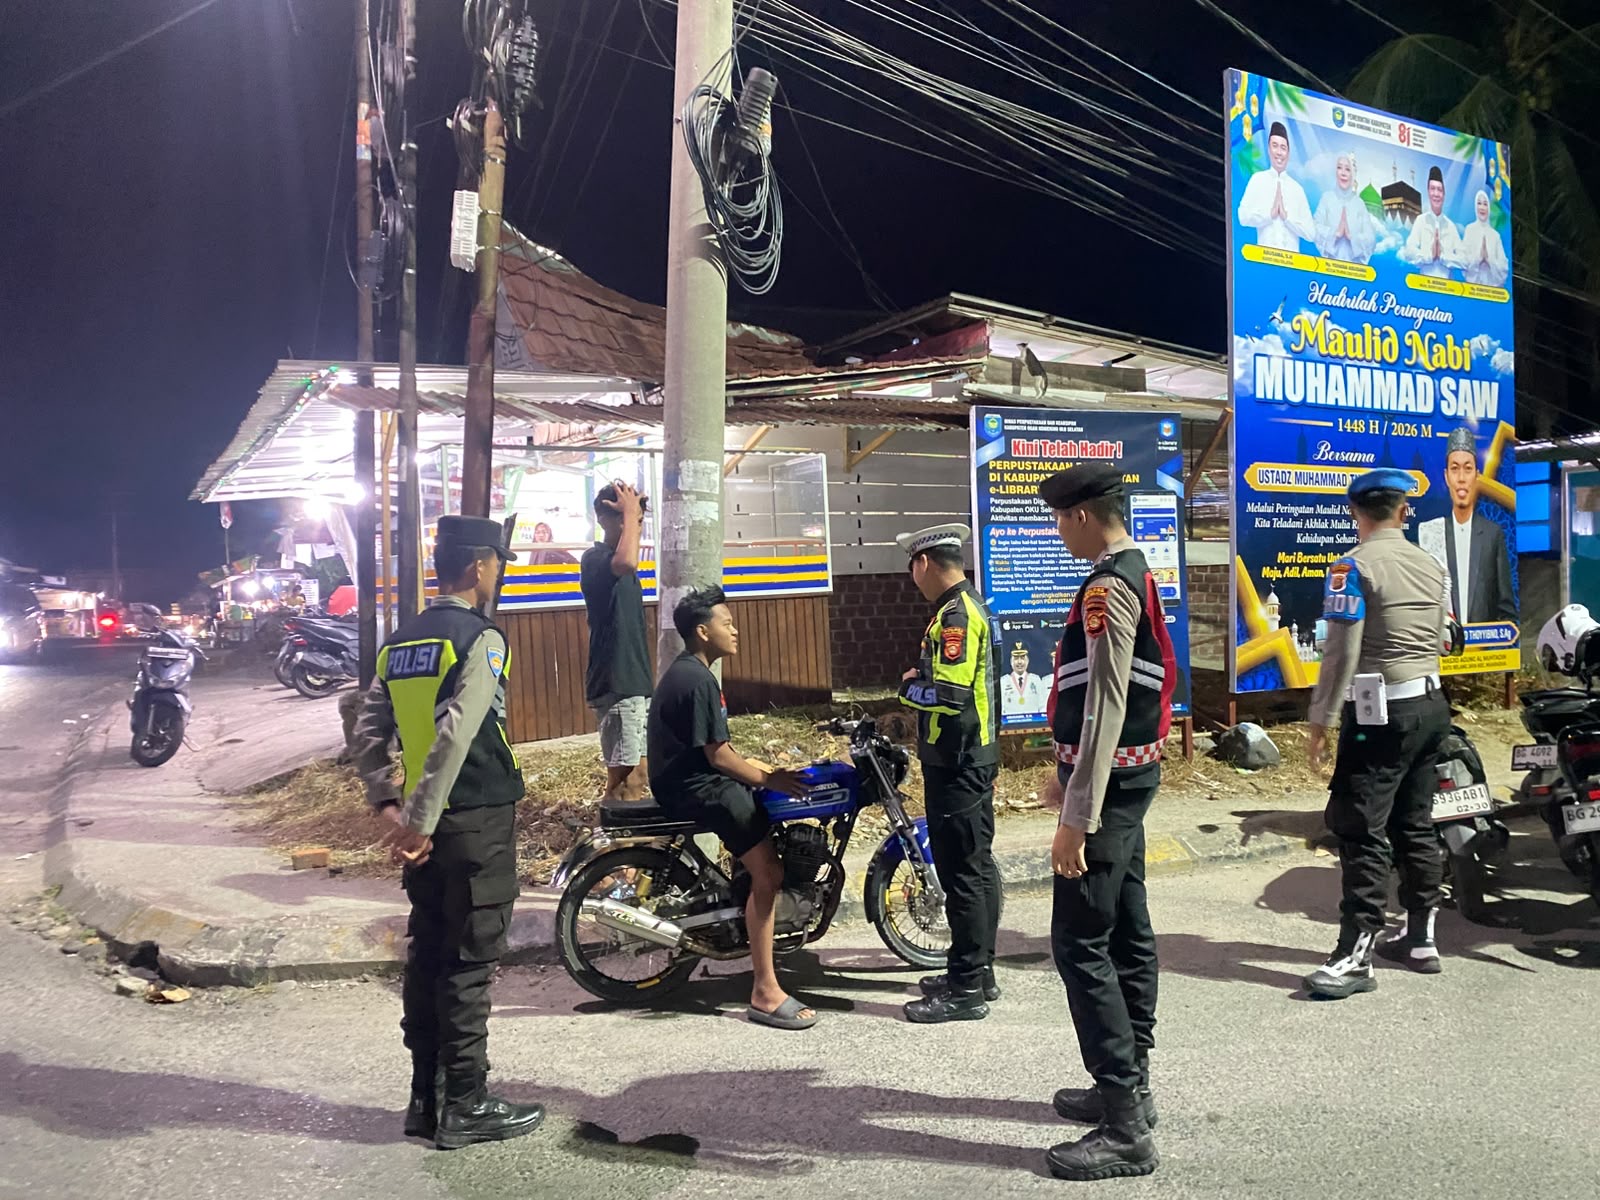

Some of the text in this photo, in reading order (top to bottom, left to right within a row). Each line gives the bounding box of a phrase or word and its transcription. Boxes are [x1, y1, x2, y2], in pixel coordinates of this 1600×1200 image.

[1398, 123, 1410, 147] 81
[1308, 281, 1453, 330] Hadirilah Peringatan
[1290, 310, 1471, 372] Maulid Nabi
[1255, 355, 1500, 419] MUHAMMAD SAW
[1337, 418, 1365, 434] 1448
[1369, 420, 1380, 435] H
[1391, 423, 1418, 437] 2026
[1420, 424, 1432, 438] M
[1012, 439, 1039, 457] Kini
[1041, 440, 1078, 457] Telah
[1312, 440, 1375, 464] Bersama
[989, 461, 1073, 471] PERPUSTAKAAN
[989, 473, 1001, 482] DI
[1258, 469, 1292, 485] USTADZ
[1294, 471, 1347, 487] MUHAMMAD
[989, 485, 1040, 494] e-LIBRAR
[1246, 502, 1274, 513] Melalui
[1276, 503, 1314, 517] Peringatan
[1316, 504, 1340, 515] Maulid
[1254, 518, 1270, 528] Kita
[1272, 518, 1302, 529] Teladani
[1304, 519, 1329, 529] Akhlak
[1330, 520, 1350, 529] Mulia
[990, 528, 1005, 537] Ayo
[1007, 527, 1016, 536] ke
[1296, 533, 1361, 546] Kehidupan Sehari-
[1277, 552, 1340, 563] Mari Bersatu Unt
[1262, 566, 1282, 581] Maju,
[1567, 808, 1585, 820] BG
